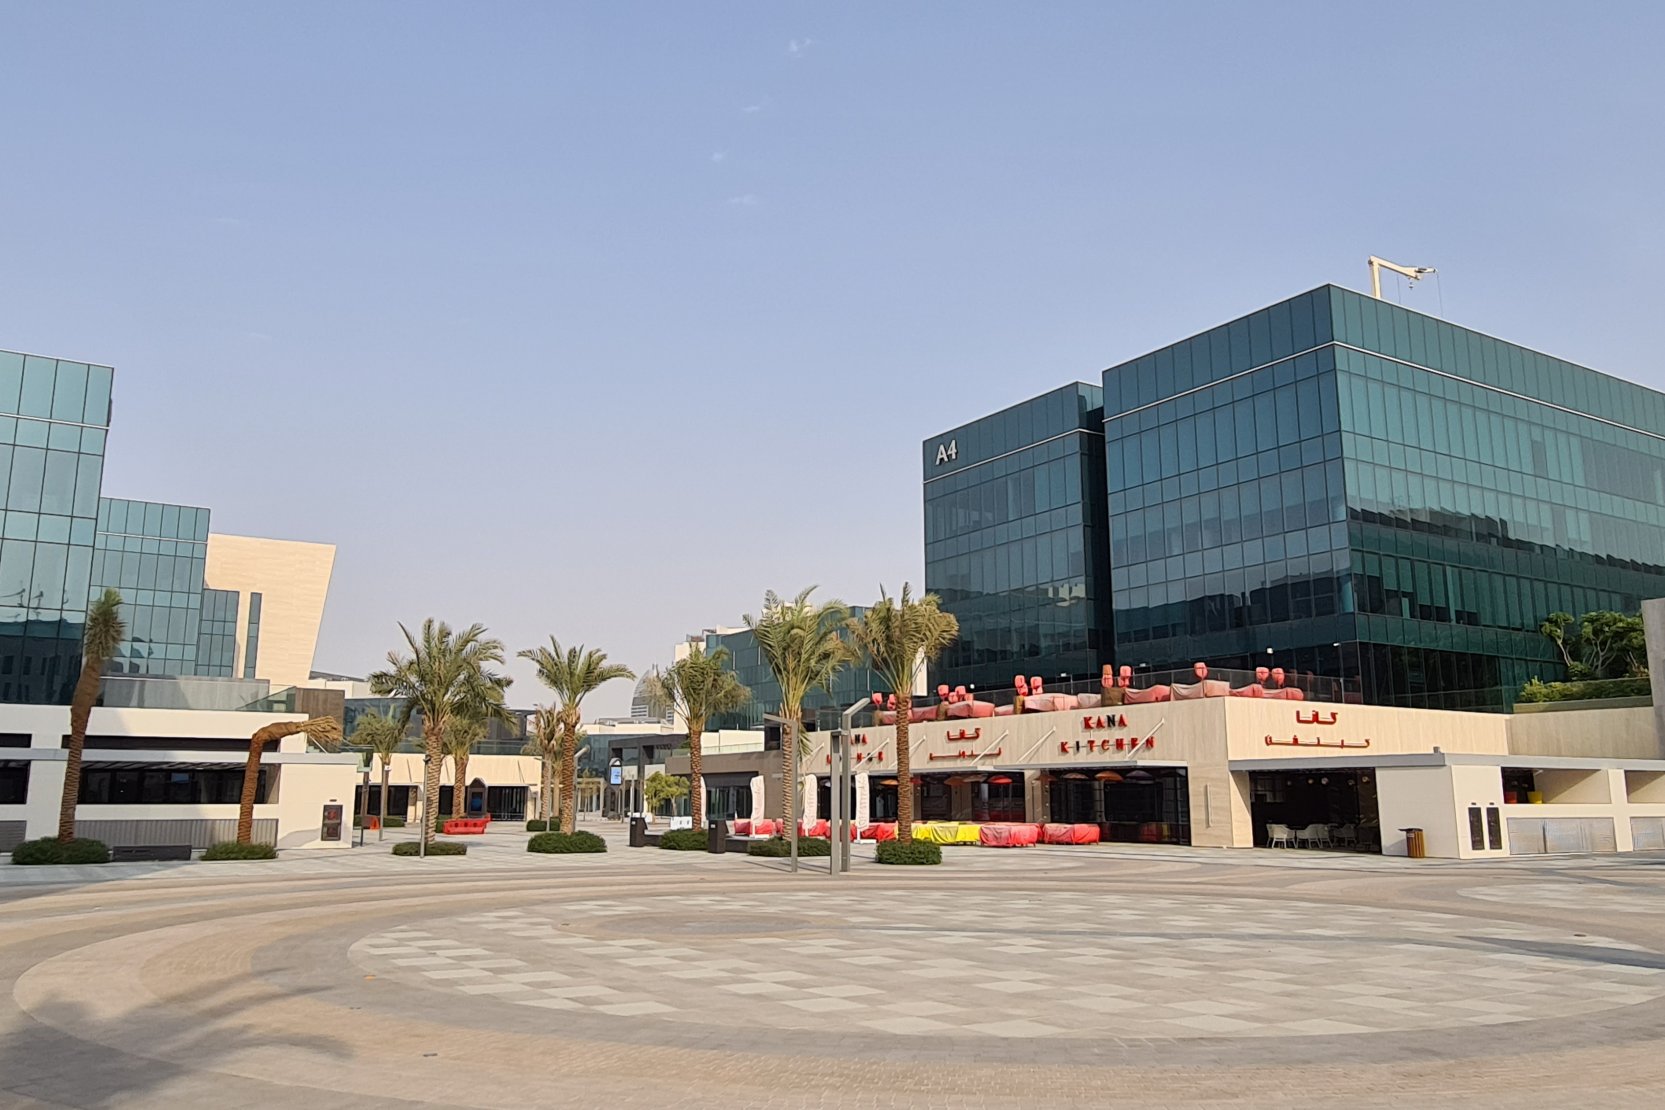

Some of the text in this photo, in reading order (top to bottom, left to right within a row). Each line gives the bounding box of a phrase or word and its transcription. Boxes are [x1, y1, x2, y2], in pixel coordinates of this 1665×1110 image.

[935, 439, 957, 465] A4
[1083, 714, 1127, 730] KANA
[1060, 736, 1156, 754] KITCHEN
